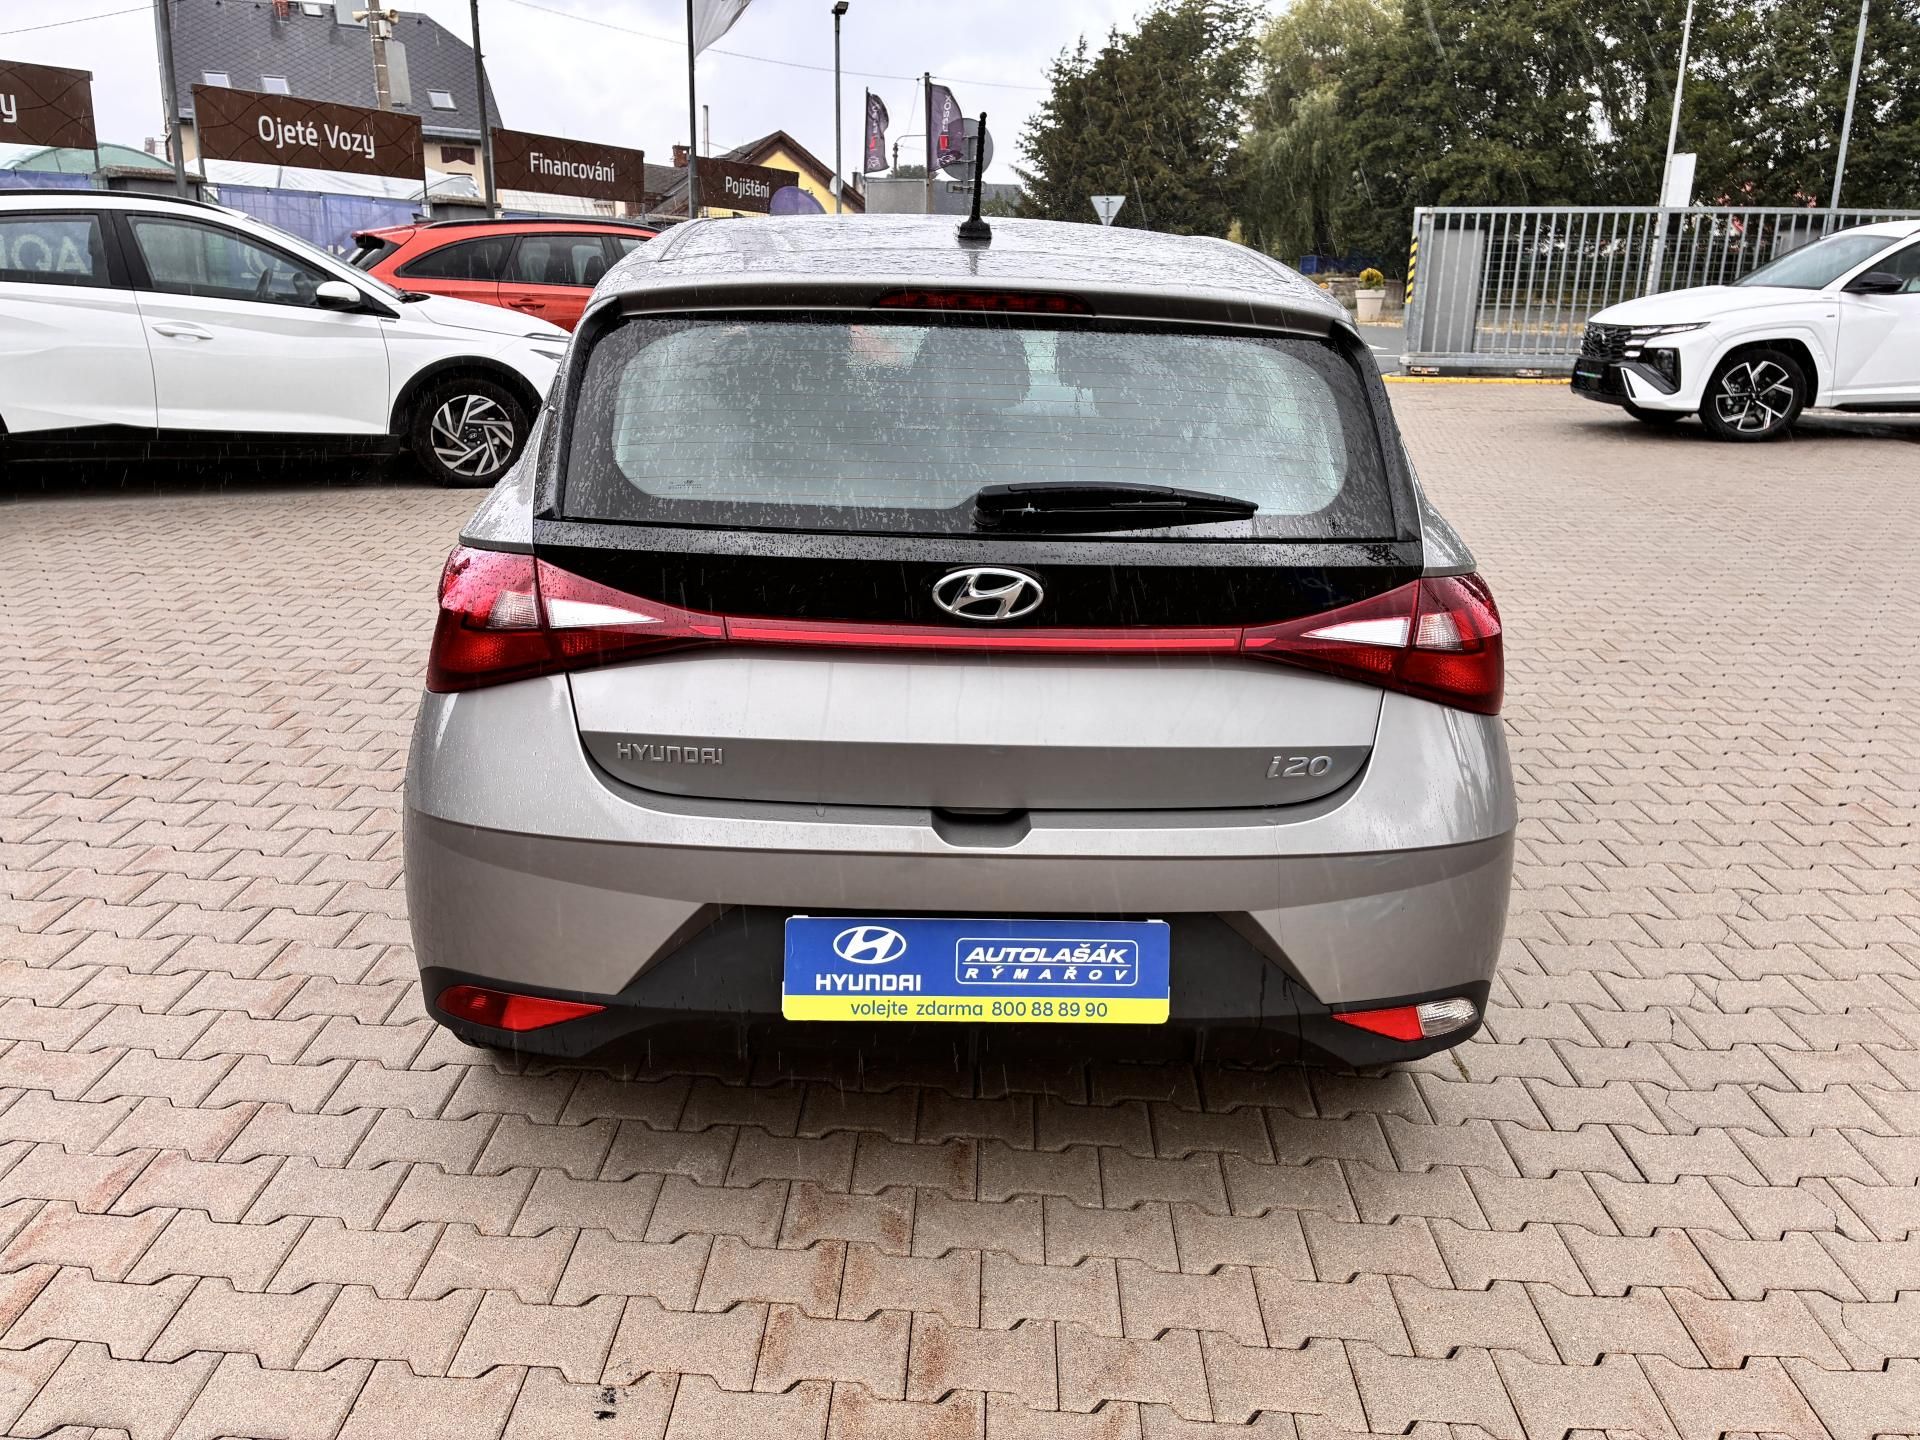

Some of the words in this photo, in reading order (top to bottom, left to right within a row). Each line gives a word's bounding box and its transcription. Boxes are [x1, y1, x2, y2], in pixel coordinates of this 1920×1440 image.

[258, 115, 318, 148] Ojeté
[324, 123, 375, 158] Vozy
[530, 152, 615, 182] Financování
[725, 175, 770, 199] Pojištění
[617, 742, 723, 765] HYUNDAI
[1266, 755, 1333, 778] i20
[964, 943, 1128, 964] AUTOLAŠÁK
[815, 973, 922, 992] HYUNDAI
[850, 999, 908, 1019] volejte
[916, 1000, 983, 1016] zdarma
[991, 1001, 1027, 1017] 800
[1031, 1002, 1054, 1017] 88
[1058, 1002, 1081, 1017] 89
[1085, 1002, 1108, 1017] 90
